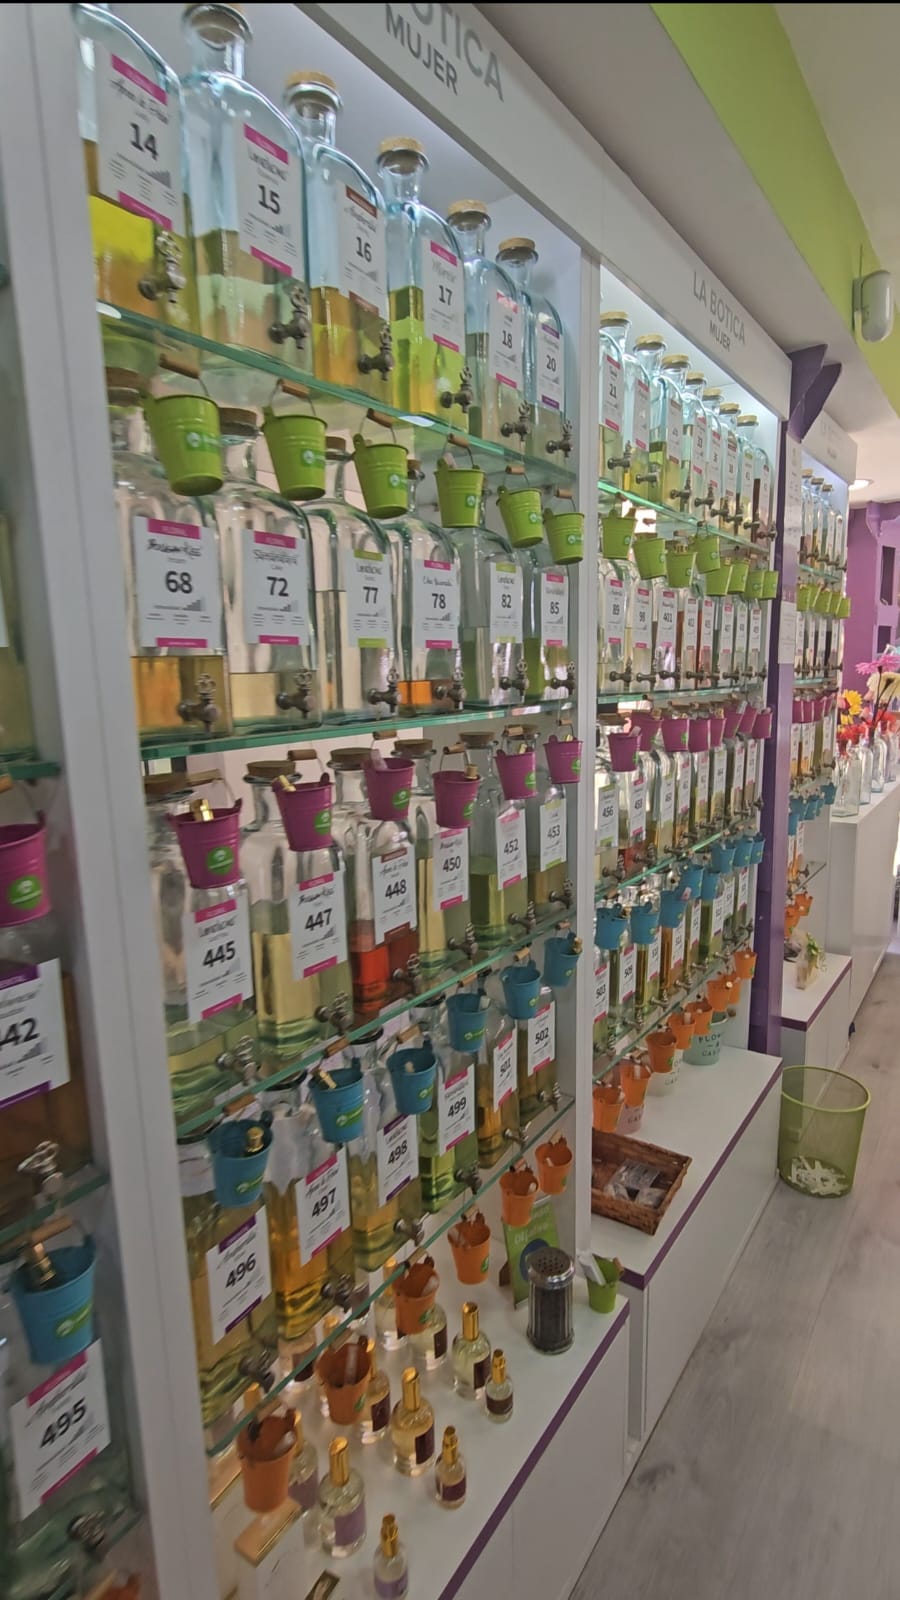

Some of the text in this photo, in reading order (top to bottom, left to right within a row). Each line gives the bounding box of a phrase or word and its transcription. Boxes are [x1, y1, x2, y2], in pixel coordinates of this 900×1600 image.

[386, 4, 458, 96] MUJER
[130, 122, 159, 160] 14
[258, 184, 281, 215] 15
[356, 236, 372, 263] 16
[439, 284, 453, 306] 17
[693, 271, 745, 345] LA BOTICA
[502, 330, 513, 349] 18
[709, 319, 731, 353] MUJER
[546, 354, 557, 372] 20
[165, 570, 193, 594] 68
[266, 576, 289, 597] 72
[362, 586, 379, 604] 77
[431, 592, 446, 610] 78
[501, 593, 512, 609] 82
[550, 601, 560, 615] 85
[547, 824, 561, 839] 453
[503, 838, 519, 854] 452
[442, 855, 461, 873] 450
[384, 879, 408, 900] 448
[304, 908, 332, 931] 447
[202, 940, 236, 968] 445
[0, 1018, 40, 1052] 42
[535, 1027, 549, 1045] 502
[447, 1096, 468, 1119] 499
[387, 1139, 408, 1164] 498
[310, 1186, 338, 1218] 497
[225, 1252, 256, 1288] 496
[38, 1395, 88, 1449] 495
